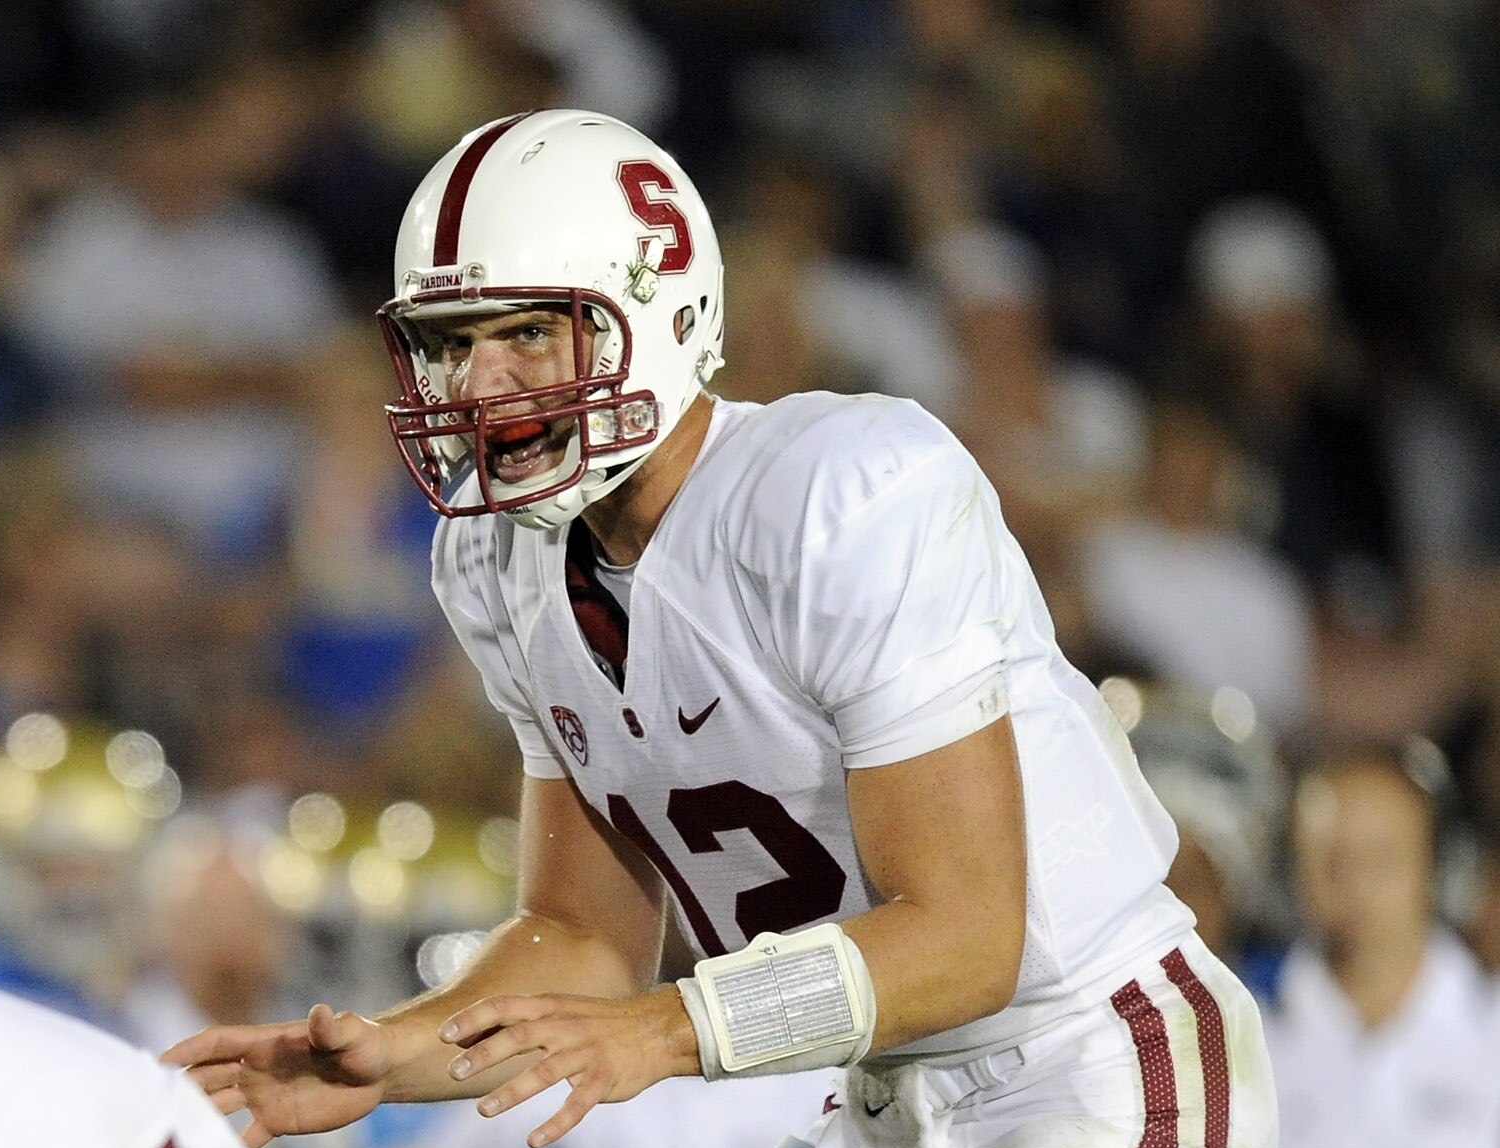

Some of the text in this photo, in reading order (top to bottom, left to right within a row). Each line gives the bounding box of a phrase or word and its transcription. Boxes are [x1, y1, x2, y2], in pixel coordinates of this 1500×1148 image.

[615, 159, 695, 275] S
[421, 273, 463, 290] CARDINA
[606, 780, 848, 958] 12
